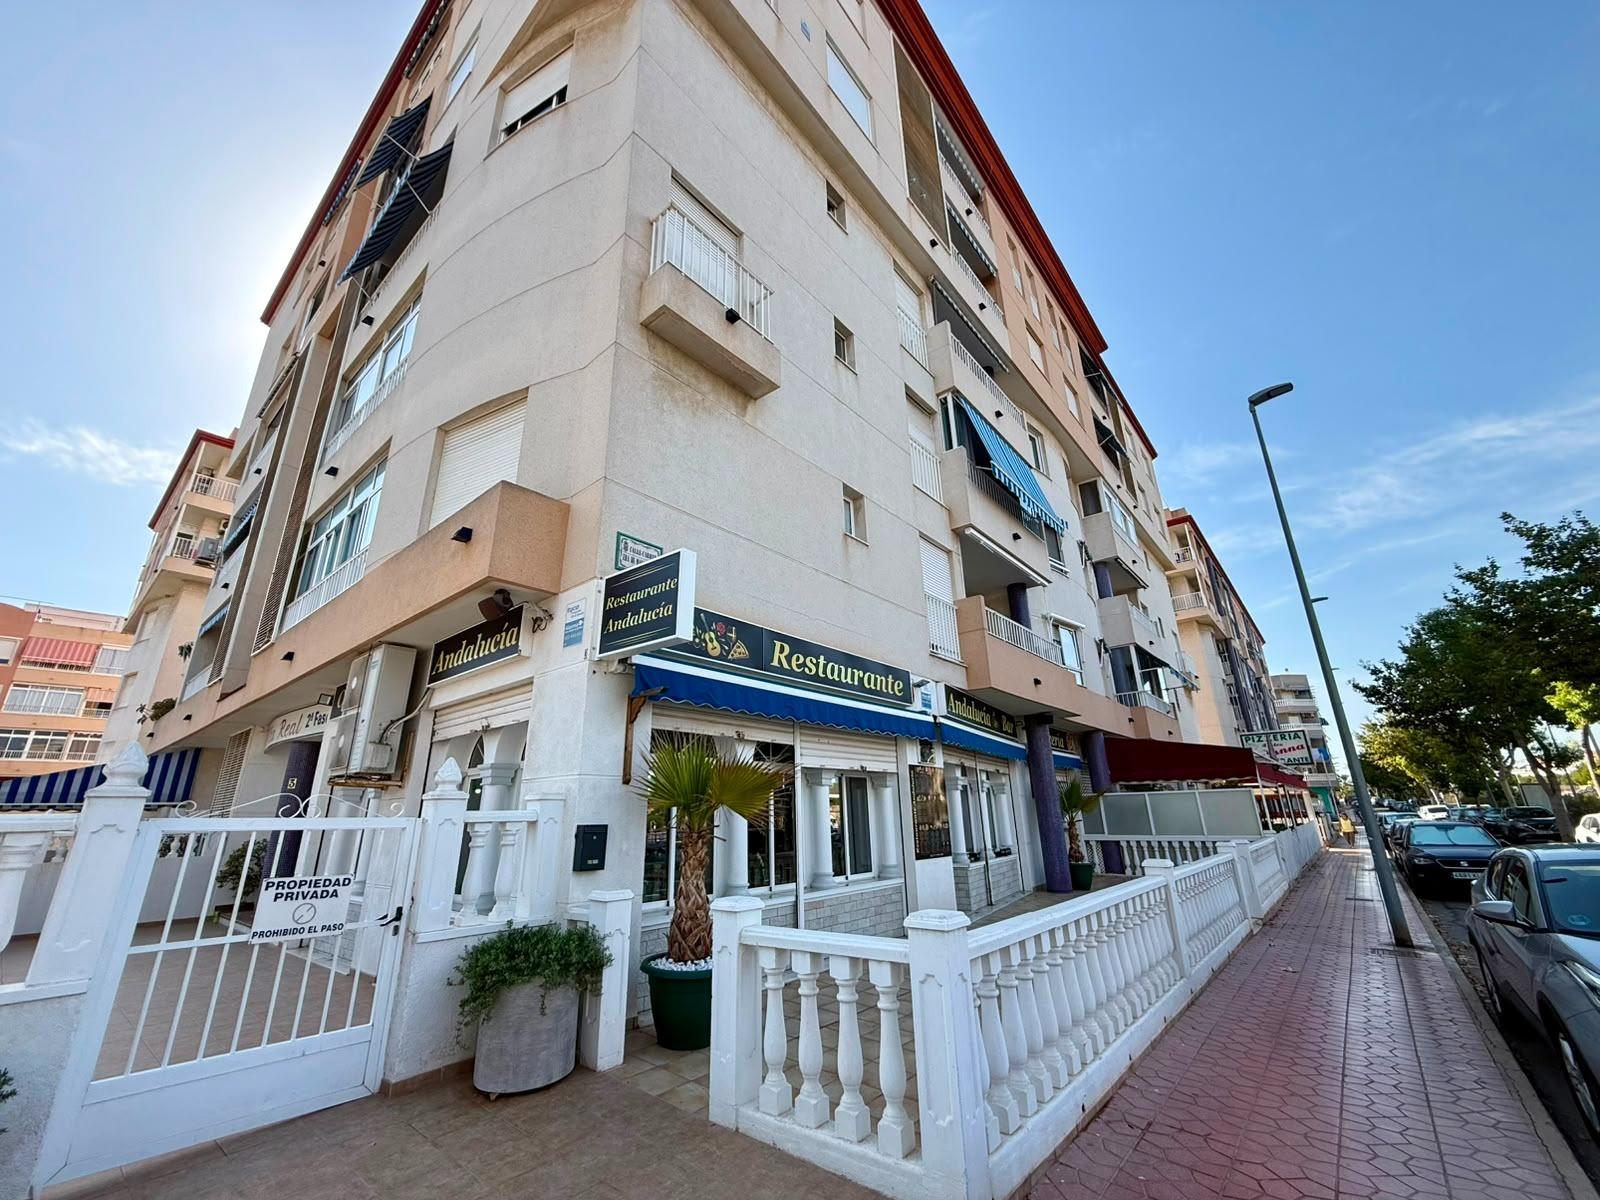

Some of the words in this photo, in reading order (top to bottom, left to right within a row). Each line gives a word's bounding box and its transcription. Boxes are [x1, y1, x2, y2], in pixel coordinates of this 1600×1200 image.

[605, 578, 678, 611] Restaurante
[603, 602, 673, 634] Andalucía
[431, 622, 519, 675] Andalucía
[770, 640, 904, 696] Restaurante
[948, 692, 992, 727] Andalucía
[280, 713, 303, 737] Real
[1244, 732, 1302, 743] PIZERIA
[264, 877, 352, 891] PROPIEDAD
[273, 889, 339, 902] PRIVADA
[251, 926, 305, 940] PROHIBIDO
[307, 925, 319, 934] EL
[320, 923, 344, 933] PASO
